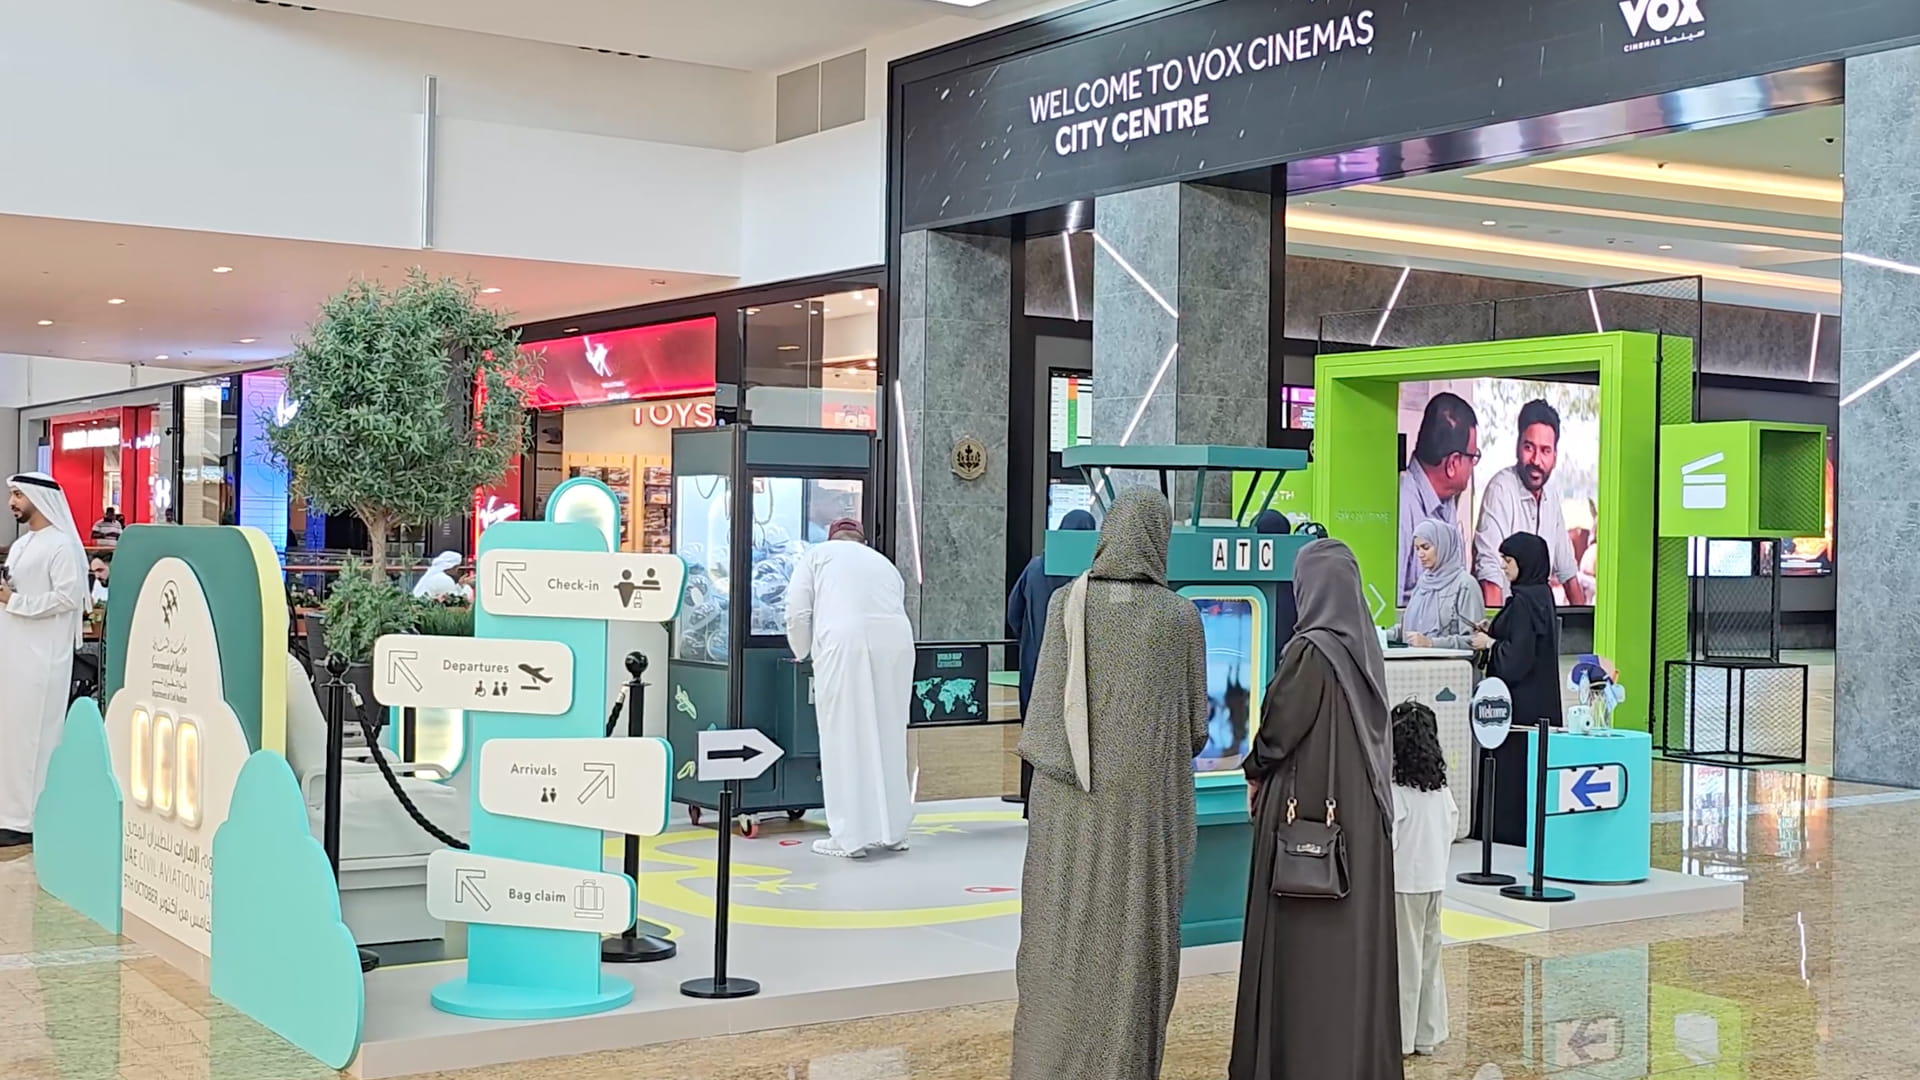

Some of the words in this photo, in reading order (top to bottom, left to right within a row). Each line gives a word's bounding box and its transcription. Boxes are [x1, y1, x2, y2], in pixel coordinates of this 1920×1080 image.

[1618, 0, 1704, 37] VOX
[1623, 38, 1661, 53] CINEMAS
[1029, 70, 1143, 123] WELCOME
[1147, 59, 1183, 95] TO
[1187, 43, 1243, 84] VOX
[1247, 10, 1375, 71] CINEMAS
[1055, 117, 1109, 156] CITY
[1111, 94, 1210, 143] CENTRE
[1214, 541, 1273, 569] ATC
[547, 577, 600, 592] Check-in
[442, 659, 510, 674] Departures
[1478, 704, 1508, 718] Welcome
[510, 762, 558, 776] Arrivals
[124, 844, 138, 867] UAE
[139, 851, 158, 878] CIVIL
[158, 862, 197, 898] AVIATION
[199, 879, 211, 904] DA
[135, 879, 158, 905] OCTOBER
[508, 887, 532, 904] Bag
[534, 890, 567, 903] claim
